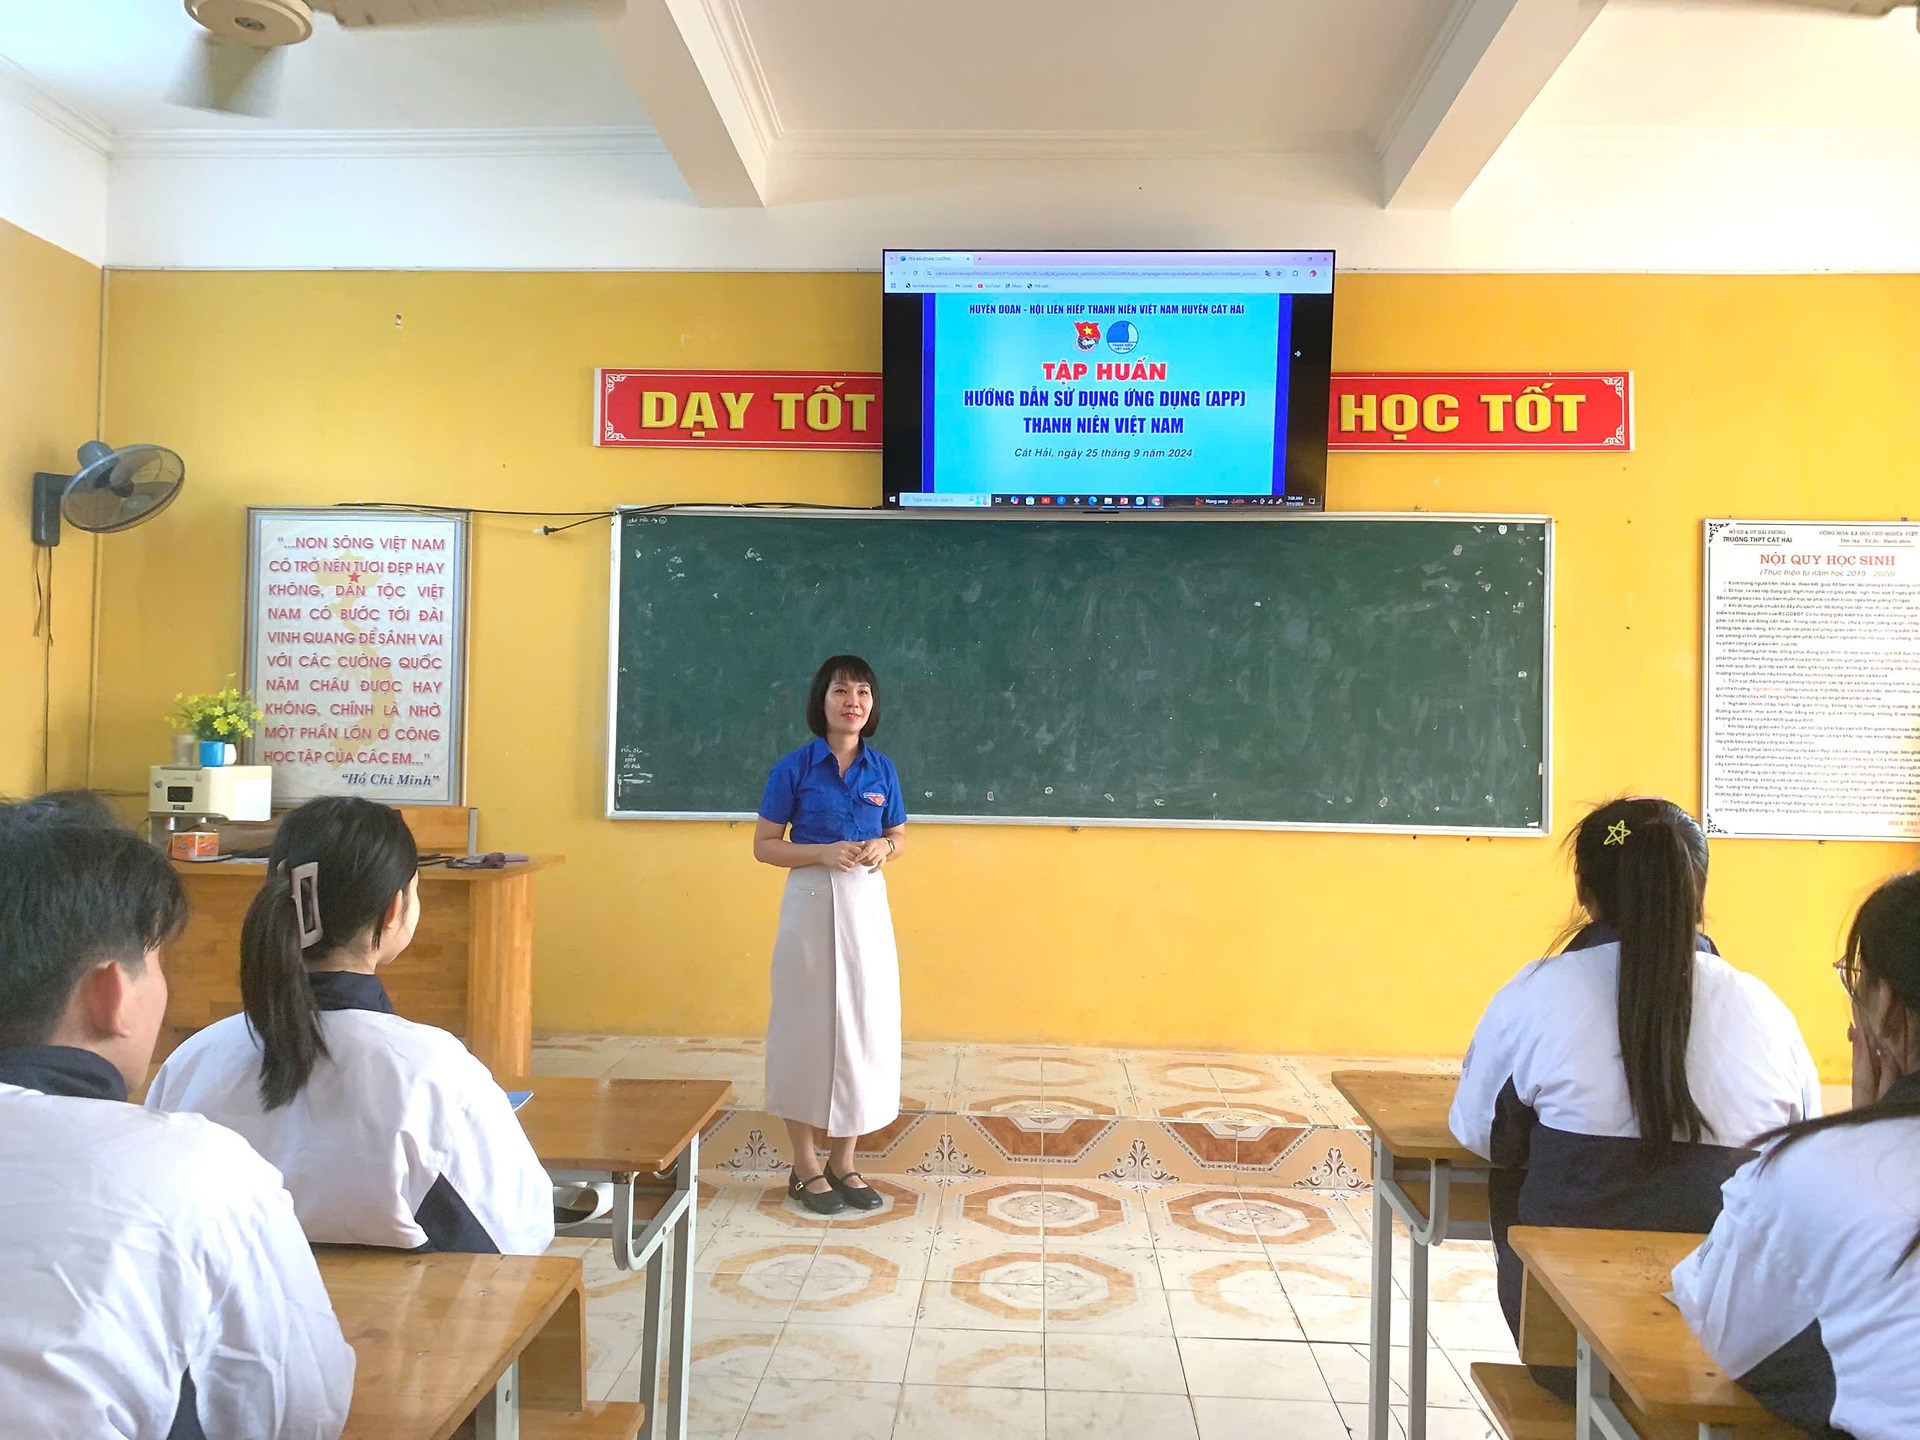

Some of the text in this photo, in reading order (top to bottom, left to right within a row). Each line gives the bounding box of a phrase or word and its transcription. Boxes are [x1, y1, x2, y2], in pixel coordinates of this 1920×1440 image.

[1088, 305, 1115, 314] THANH
[1118, 304, 1136, 314] NIÊN
[1140, 304, 1157, 315] VIỆT
[1160, 305, 1178, 314] NAM
[1043, 357, 1167, 385] TẬP HUẤN
[964, 387, 1015, 407] HƯỚNG
[1020, 386, 1049, 406] DẪN
[1054, 387, 1075, 407] SỬ
[1079, 391, 1120, 409] DỤNG
[1124, 387, 1156, 406] ỨNG
[1160, 391, 1200, 410] DỤNG
[641, 382, 875, 438] DẠY TỐT
[1340, 382, 1586, 440] HỌC TỐT
[1024, 414, 1183, 437] THANH NIÊN VIỆT NAM
[1015, 446, 1192, 459] Cát Hải, ngày 25 tháng 9 năm 2024
[333, 535, 374, 549] SÔNG
[380, 537, 406, 552] VIỆT
[411, 538, 445, 549] NAM
[269, 558, 290, 573] CÓ
[323, 559, 350, 573] NÊN
[354, 561, 384, 573] TƯƠI
[388, 562, 412, 577] ĐẸP
[416, 562, 445, 574] HAY
[1760, 552, 1895, 568] NỘI QUY HỌC SINH
[336, 582, 365, 596] DÂN
[378, 583, 405, 600] TỘC
[418, 584, 444, 600] VIỆT
[268, 606, 442, 622] NAM CÓ BƯỚC TỚI ĐÀI
[268, 629, 442, 645] VINH QUANG ĐỂ SÁNH VAI
[268, 652, 442, 670] VỚI CÁC CƯỜNG QUỐC
[266, 677, 442, 695] NĂM CHÂU ĐƯỢC HAY
[330, 701, 374, 716] CHÍNH
[383, 702, 400, 716] LÀ
[409, 703, 441, 717] NHỜ
[265, 725, 294, 741] MỘT
[300, 723, 338, 739] PHẦN
[344, 725, 372, 739] LỚN
[395, 726, 440, 741] CÔNG
[264, 751, 296, 766] HỌC
[298, 749, 322, 765] TẬP
[324, 748, 354, 763] CỦA
[354, 749, 388, 764] CÁC
[371, 774, 394, 786] Chí
